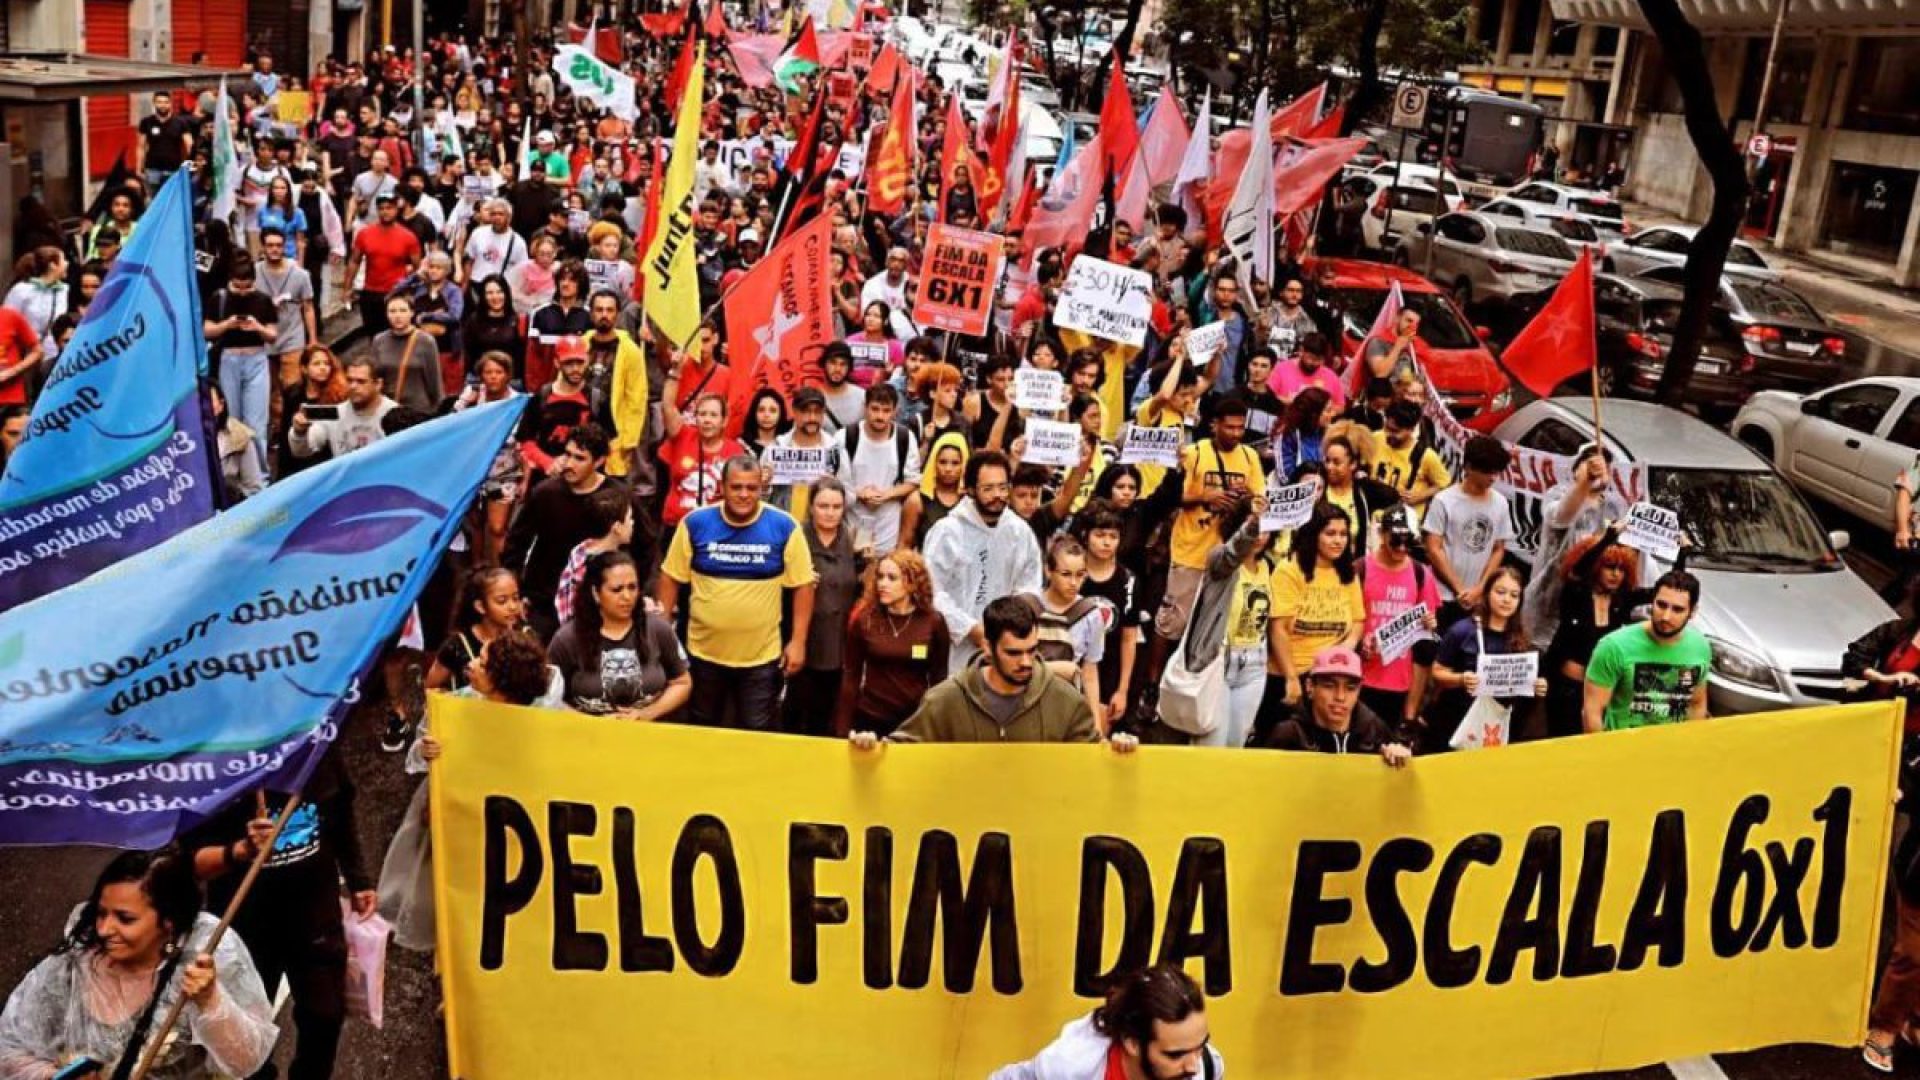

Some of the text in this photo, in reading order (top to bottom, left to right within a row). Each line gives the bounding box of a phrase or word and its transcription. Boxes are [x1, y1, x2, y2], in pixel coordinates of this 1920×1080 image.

[935, 243, 988, 267] FIM DA
[932, 260, 985, 282] ESCALA
[927, 278, 982, 310] 6X1
[480, 786, 1852, 998] PELO FIM DA ESCALA 6x1
